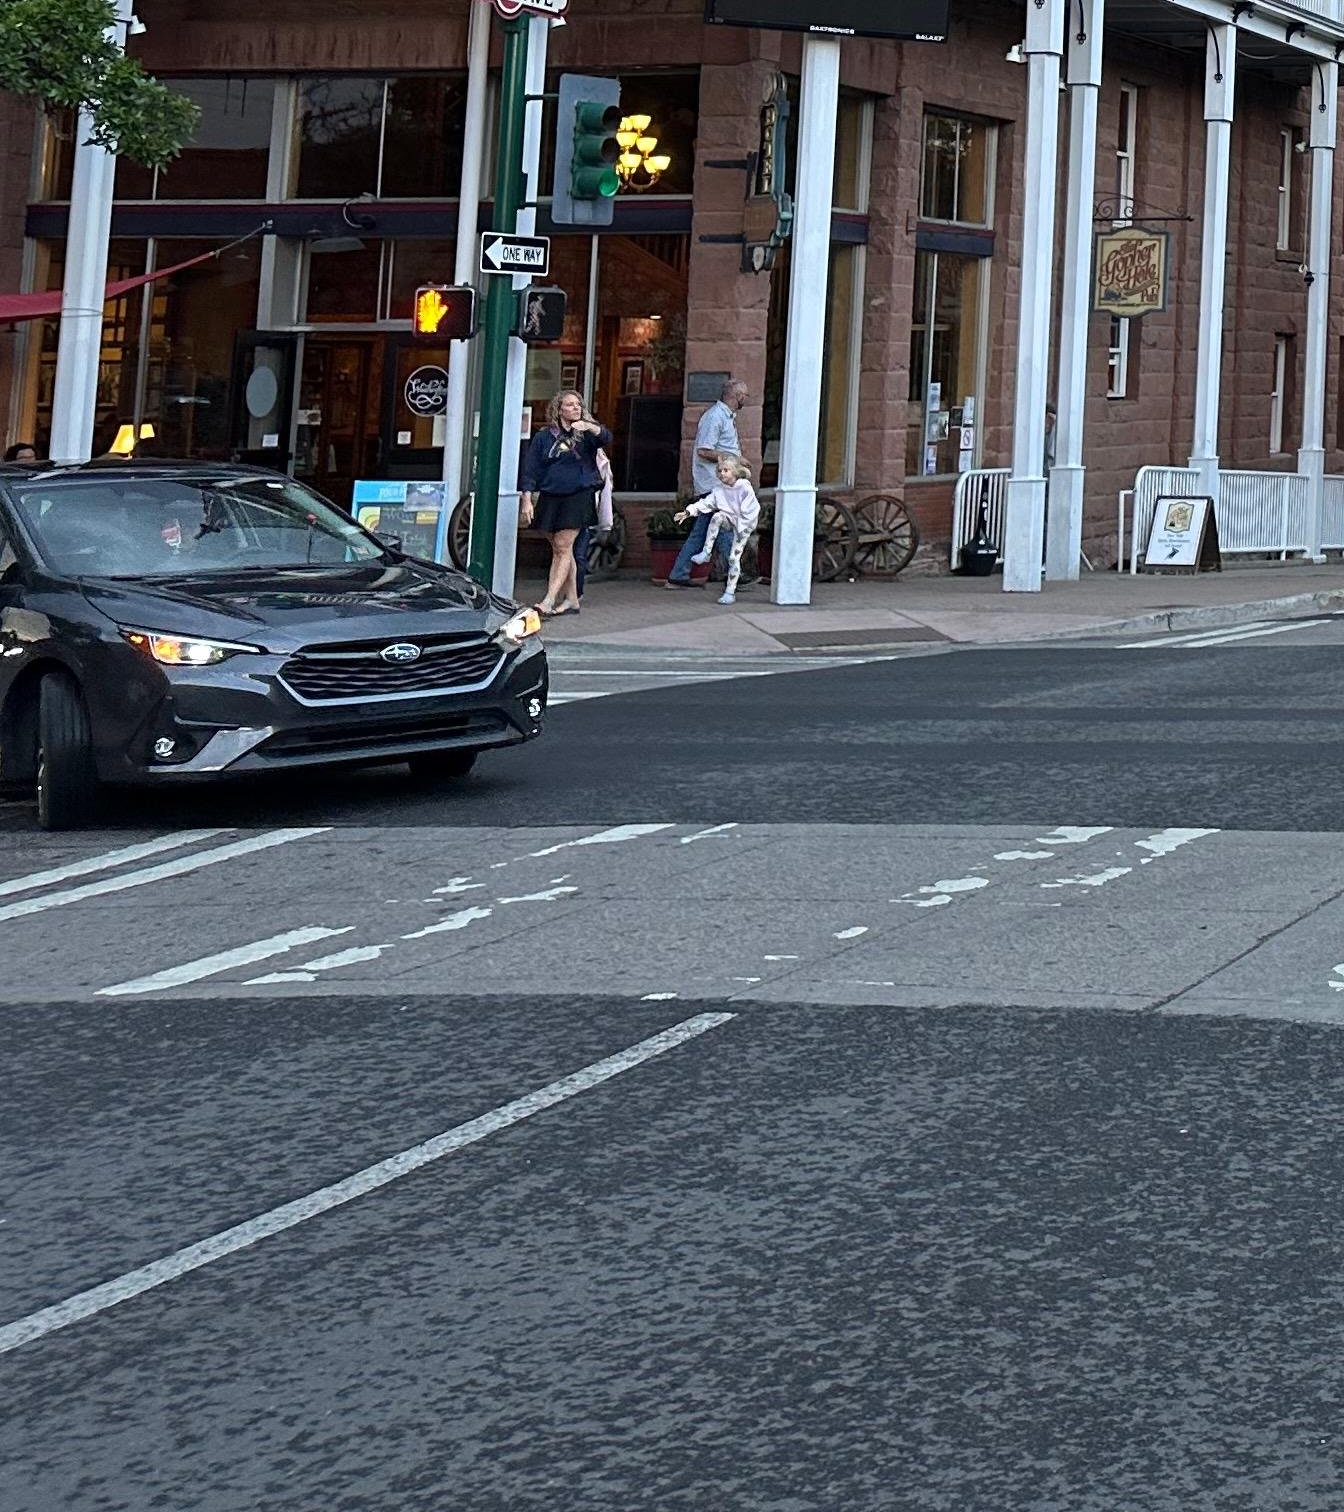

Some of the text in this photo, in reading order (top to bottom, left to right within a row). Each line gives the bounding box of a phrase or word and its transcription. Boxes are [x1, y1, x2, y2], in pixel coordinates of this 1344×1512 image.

[502, 246, 542, 263] ONE WAY
[1099, 241, 1157, 287] Gopher
